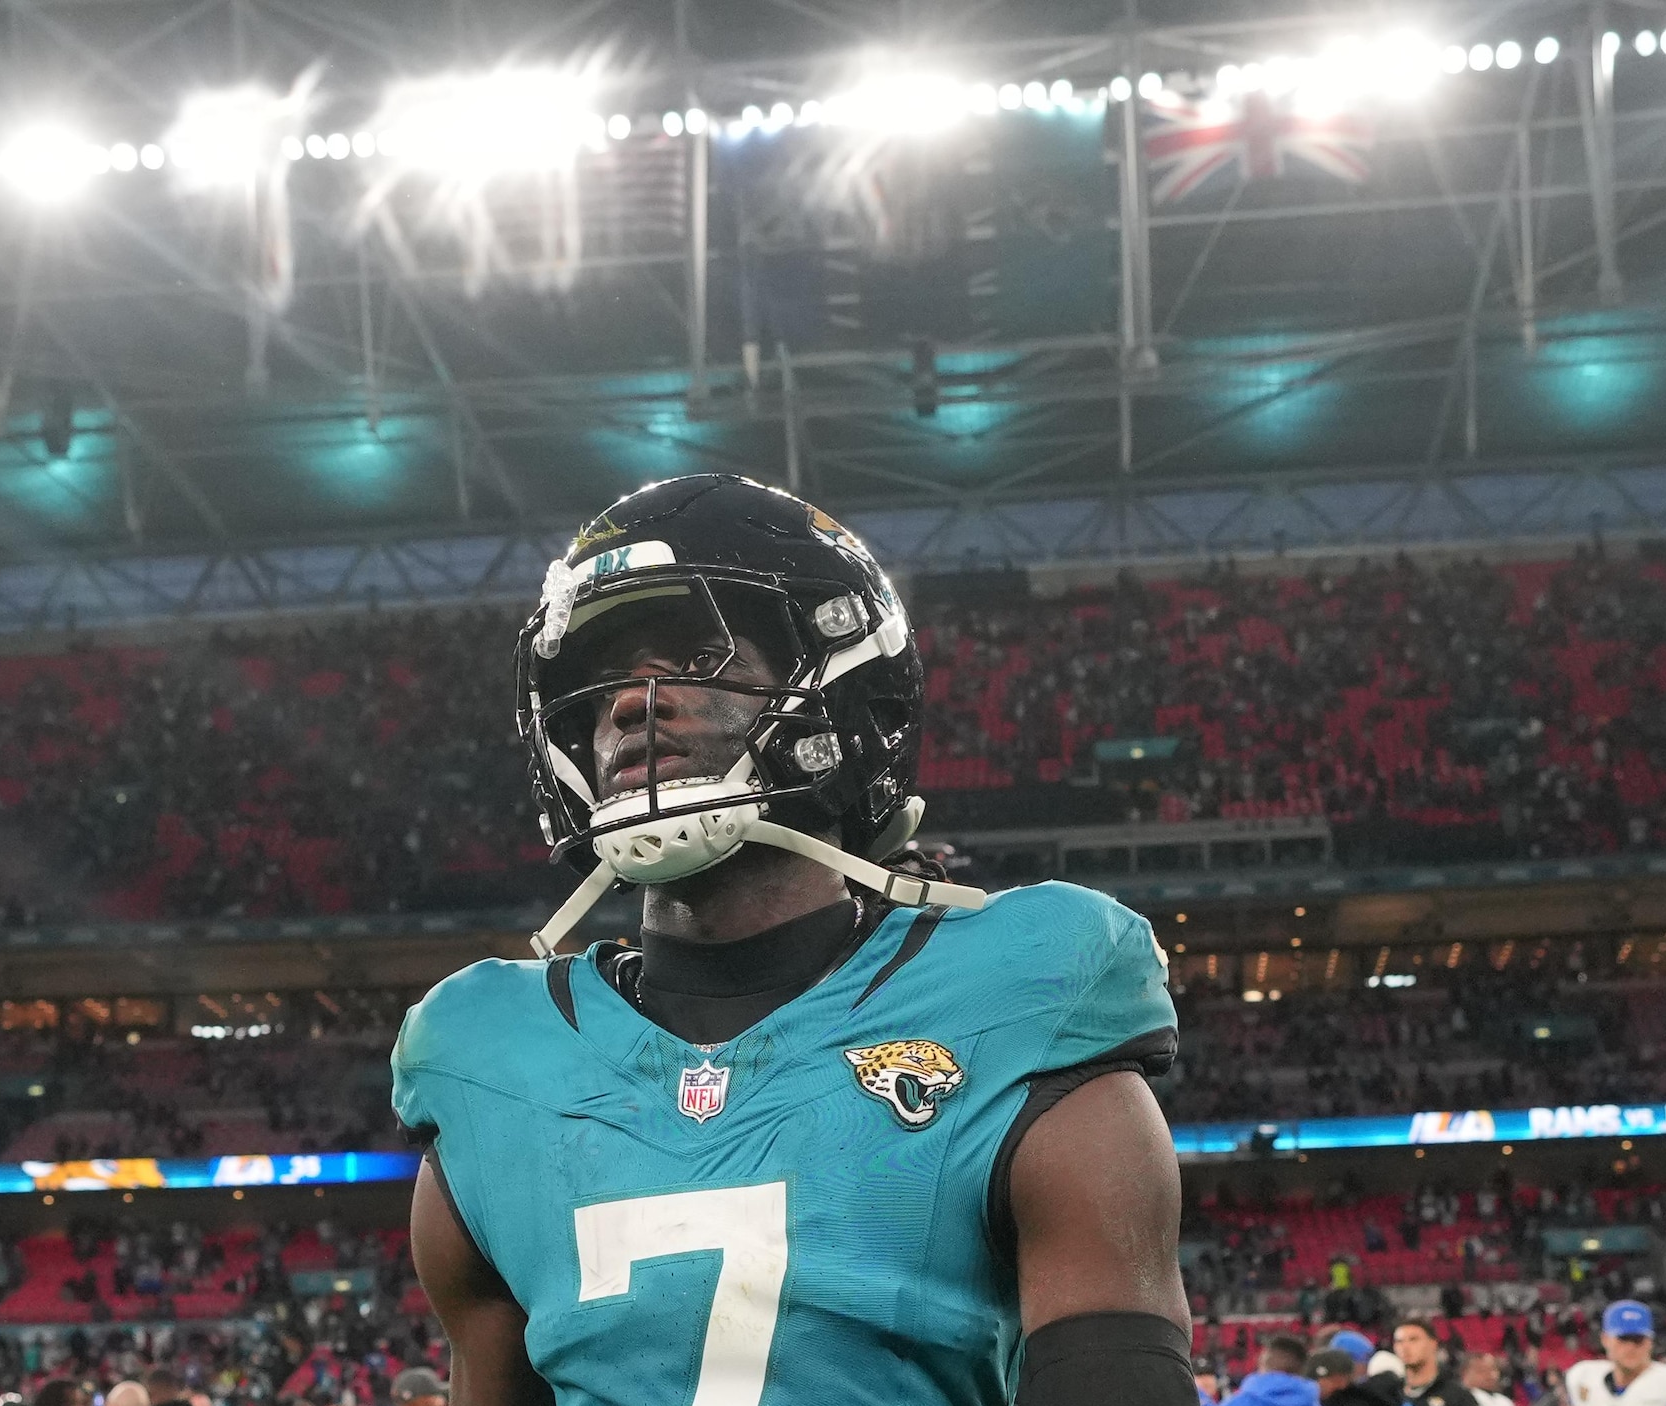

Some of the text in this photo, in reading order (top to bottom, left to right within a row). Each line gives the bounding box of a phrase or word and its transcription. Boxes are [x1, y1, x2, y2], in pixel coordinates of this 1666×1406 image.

[587, 546, 632, 582] JAX
[685, 1088, 717, 1112] NFL
[1528, 1104, 1621, 1138] RAMS
